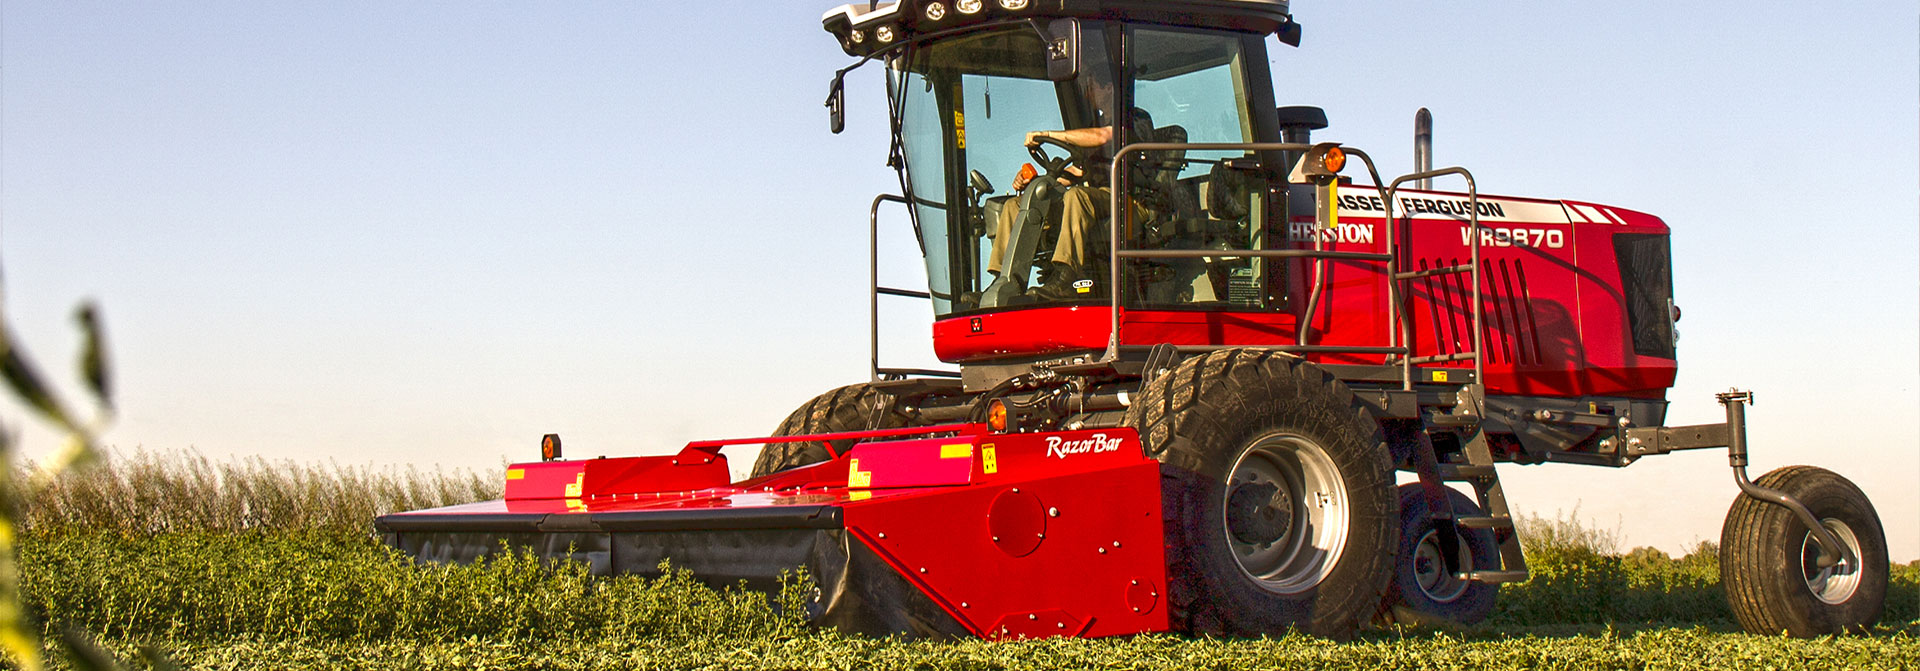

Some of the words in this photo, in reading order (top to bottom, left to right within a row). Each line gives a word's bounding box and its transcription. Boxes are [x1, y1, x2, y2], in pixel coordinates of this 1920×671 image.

[1311, 193, 1394, 211] ASSE
[1400, 198, 1505, 217] FERGUSON
[1460, 227, 1564, 249] WR9870
[1045, 433, 1123, 459] RazorBar
